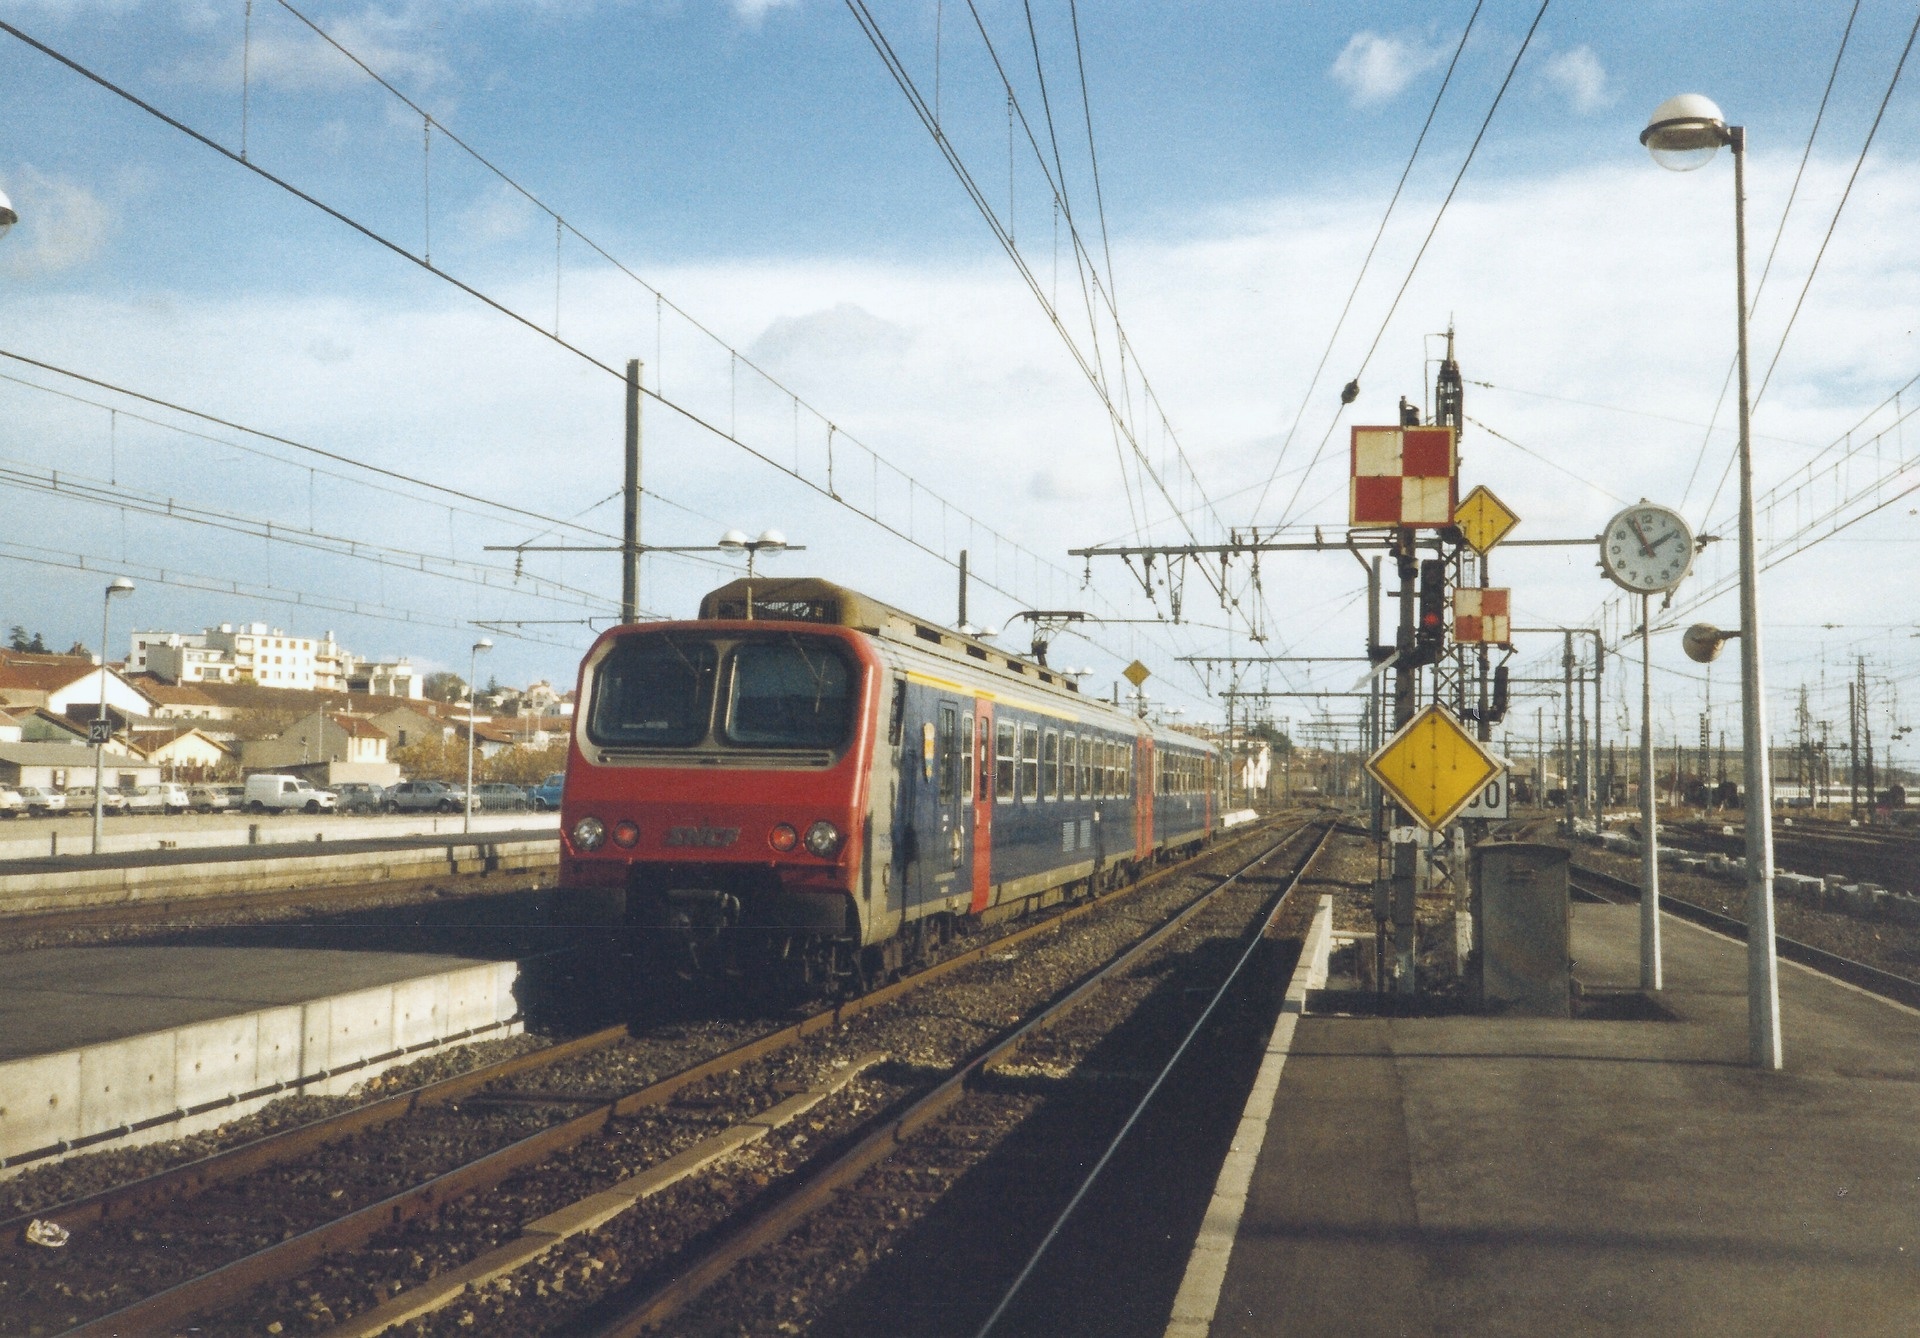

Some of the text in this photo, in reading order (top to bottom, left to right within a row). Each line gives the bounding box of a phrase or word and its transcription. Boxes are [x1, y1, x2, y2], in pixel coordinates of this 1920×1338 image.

[1642, 514, 1653, 524] 12
[1615, 530, 1627, 541] 10
[1611, 545, 1621, 555] 9
[1675, 542, 1685, 554] 3
[1617, 560, 1627, 570] 8
[1669, 559, 1680, 568] 4
[1628, 571, 1637, 581] 7
[1644, 575, 1654, 585] 6
[1661, 569, 1670, 581] 5
[663, 826, 740, 848] SNCF
